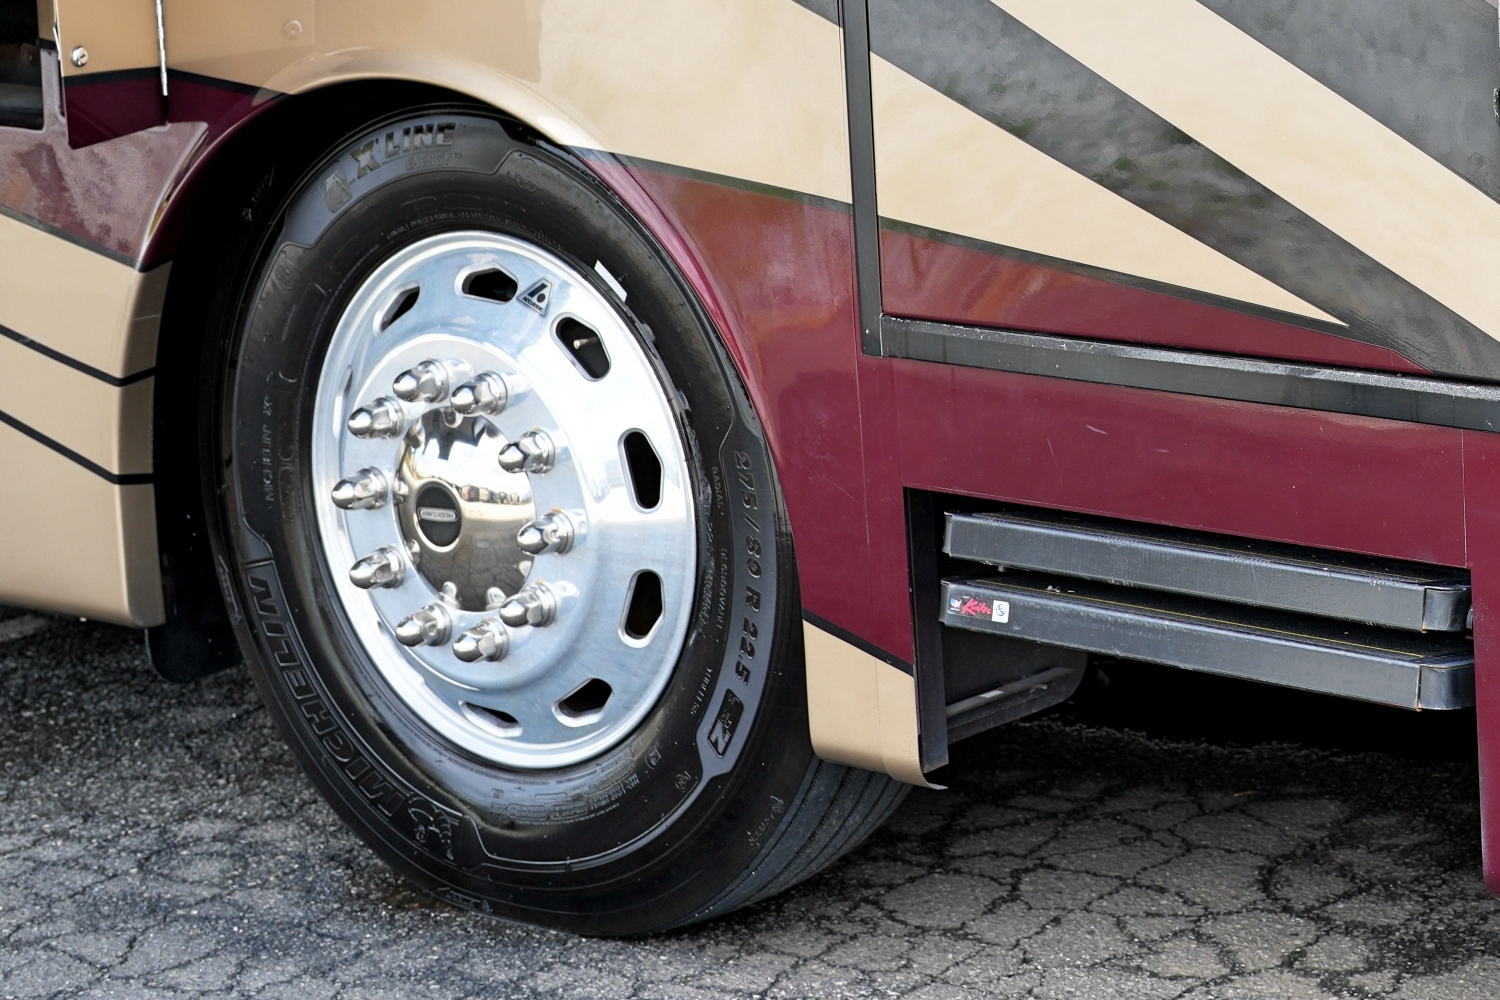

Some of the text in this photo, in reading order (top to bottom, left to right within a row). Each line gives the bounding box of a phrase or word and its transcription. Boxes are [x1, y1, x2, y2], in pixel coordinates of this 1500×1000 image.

[385, 122, 456, 158] LINE
[405, 153, 451, 171] ENERGY
[262, 427, 275, 501] MICHELIN
[711, 466, 723, 509] RADIAL
[422, 510, 454, 518] FREIGHTLINER
[745, 584, 762, 612] R
[735, 617, 759, 686] 22.5
[250, 576, 405, 818] MICHELIN
